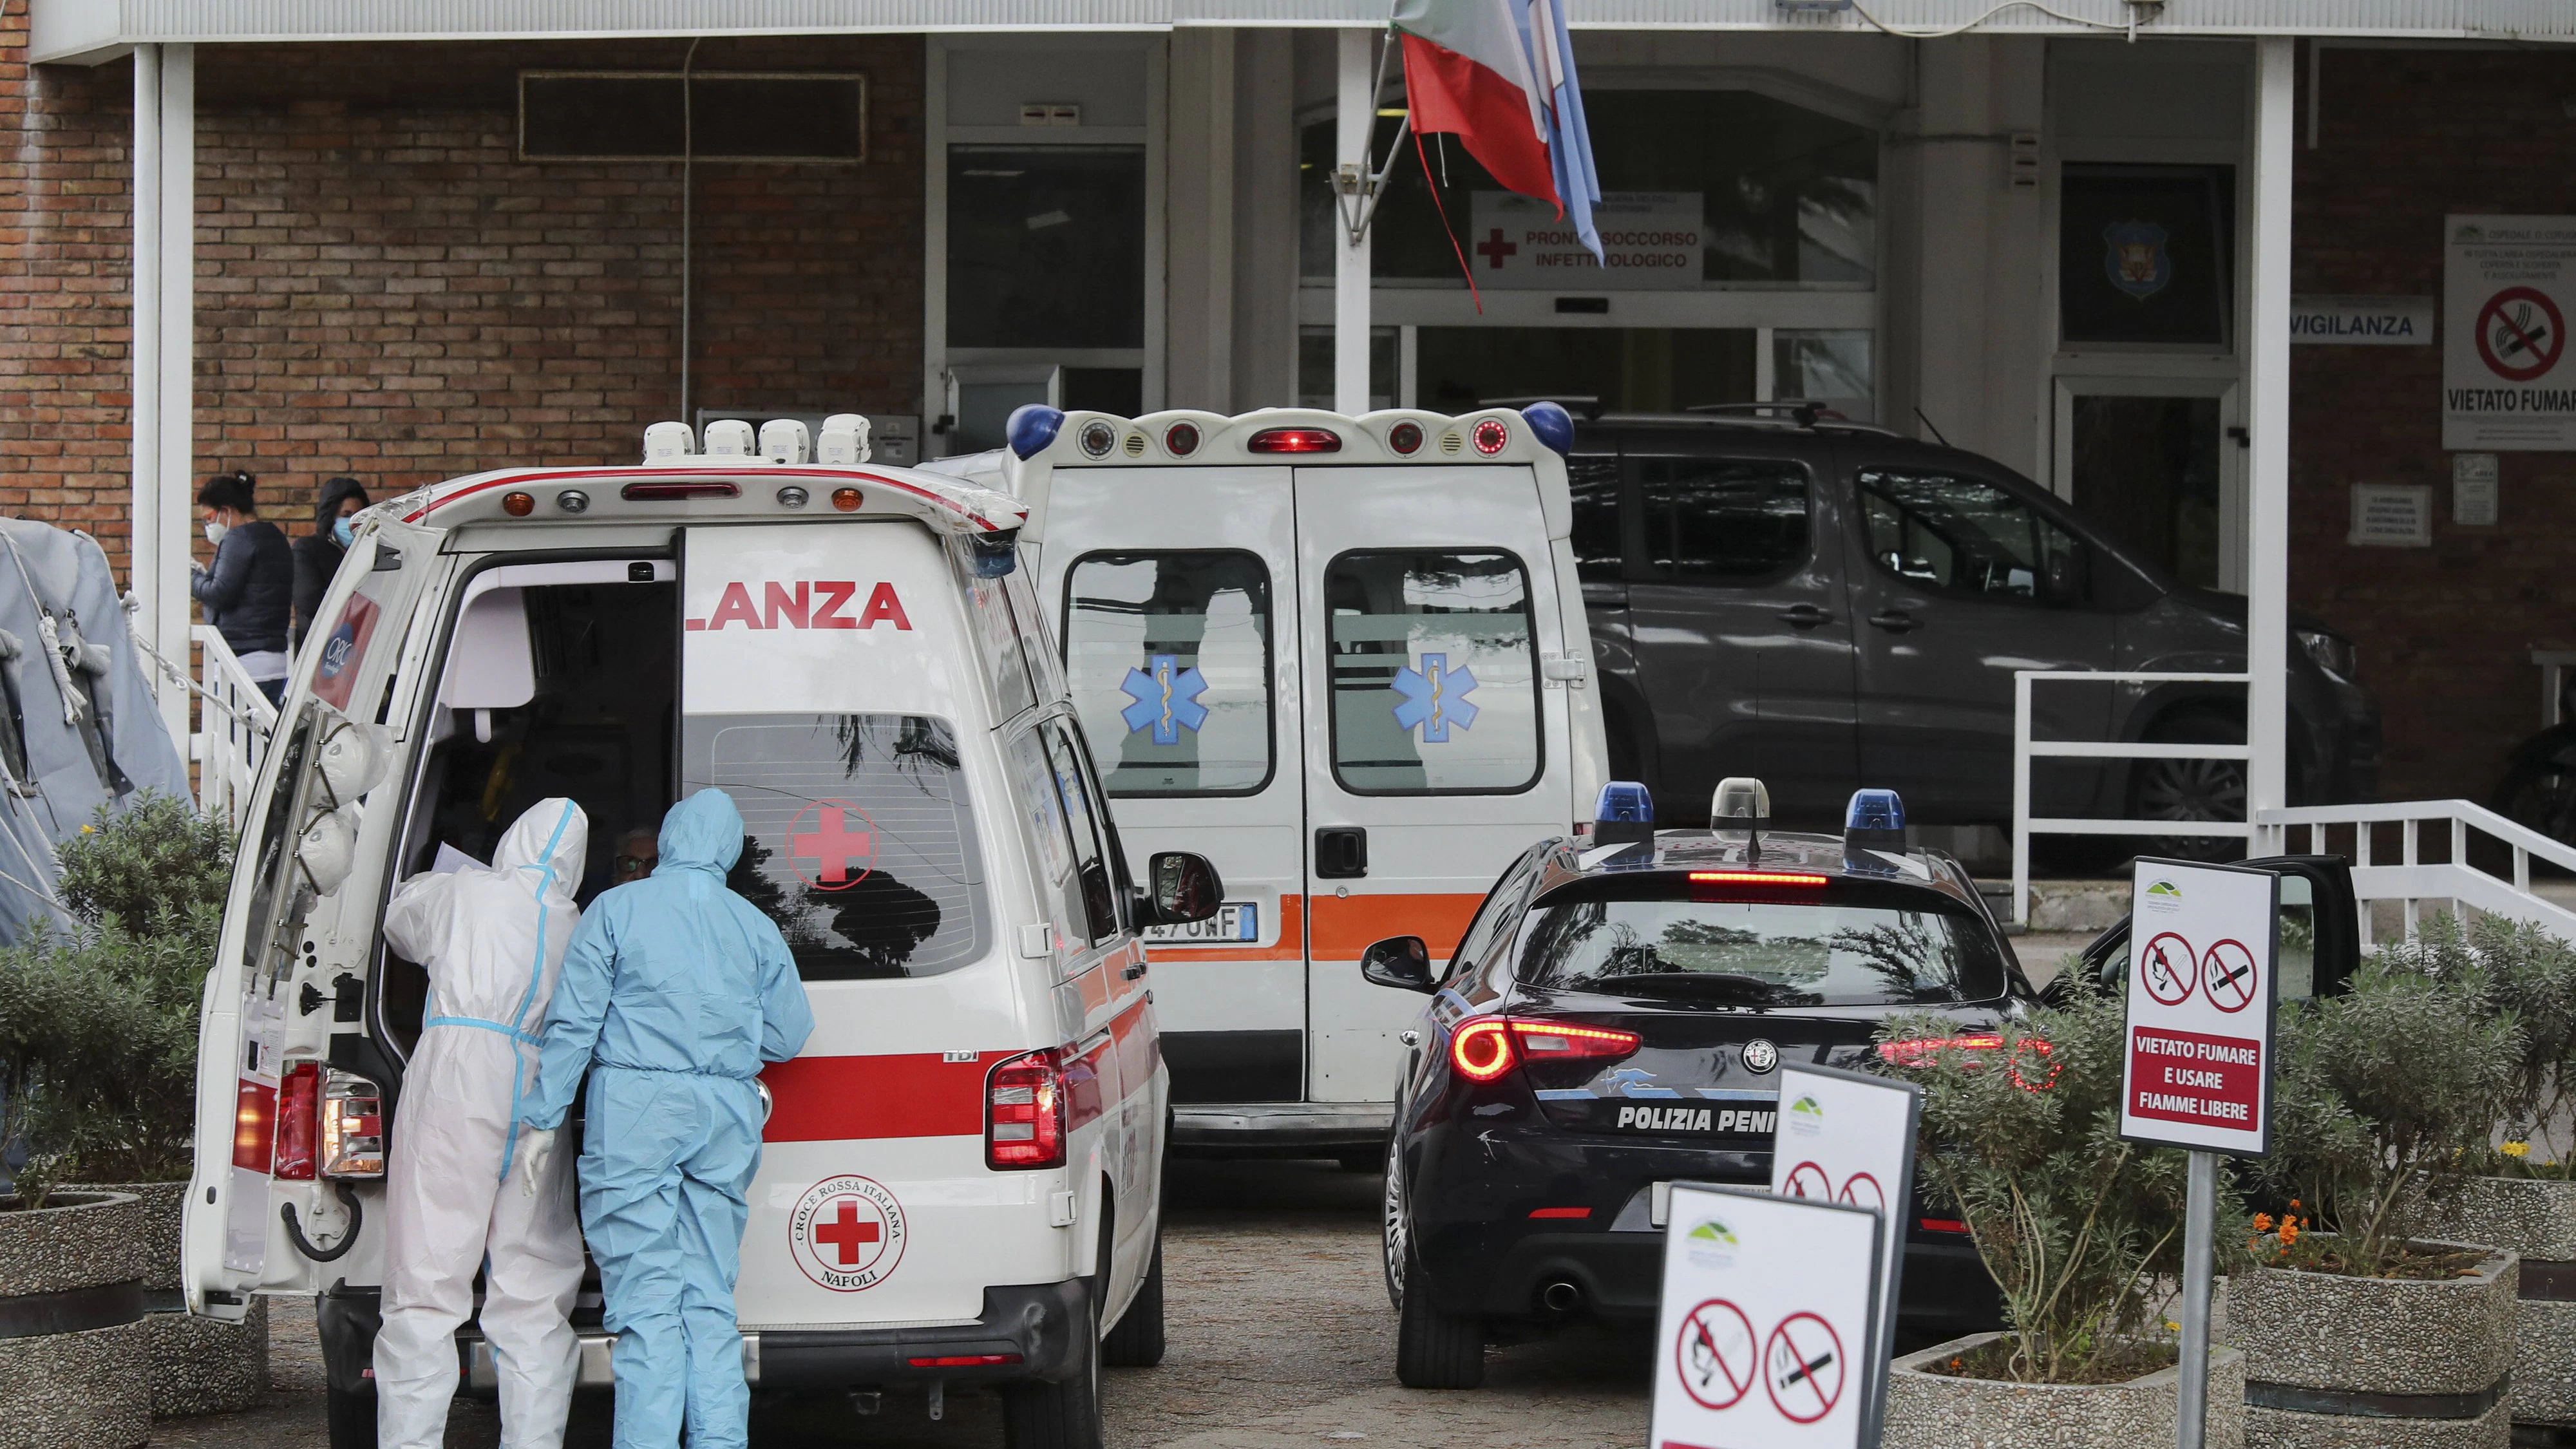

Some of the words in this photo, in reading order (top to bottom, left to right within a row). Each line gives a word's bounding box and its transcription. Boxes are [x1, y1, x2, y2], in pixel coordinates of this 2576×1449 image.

[1526, 231, 1582, 245] PRONT
[1600, 231, 1698, 246] SOCCORSO
[2290, 314, 2413, 336] VIGILANZA
[2448, 388, 2517, 411] VIETATO
[2136, 1036, 2195, 1058] VIETATO
[2197, 1043, 2257, 1066] FUMARE
[2164, 1066, 2174, 1083] E
[2175, 1068, 2223, 1090] USARE
[2139, 1091, 2197, 1114] FIAMME
[2200, 1099, 2248, 1121] LIBERE
[1617, 1106, 1711, 1132] POLIZIA
[1717, 1110, 1776, 1133] PENI
[795, 1195, 818, 1241] CROCE
[819, 1180, 860, 1198] ROSSA
[864, 1184, 901, 1240] ITALIANA
[821, 1270, 878, 1287] NAPOLI
